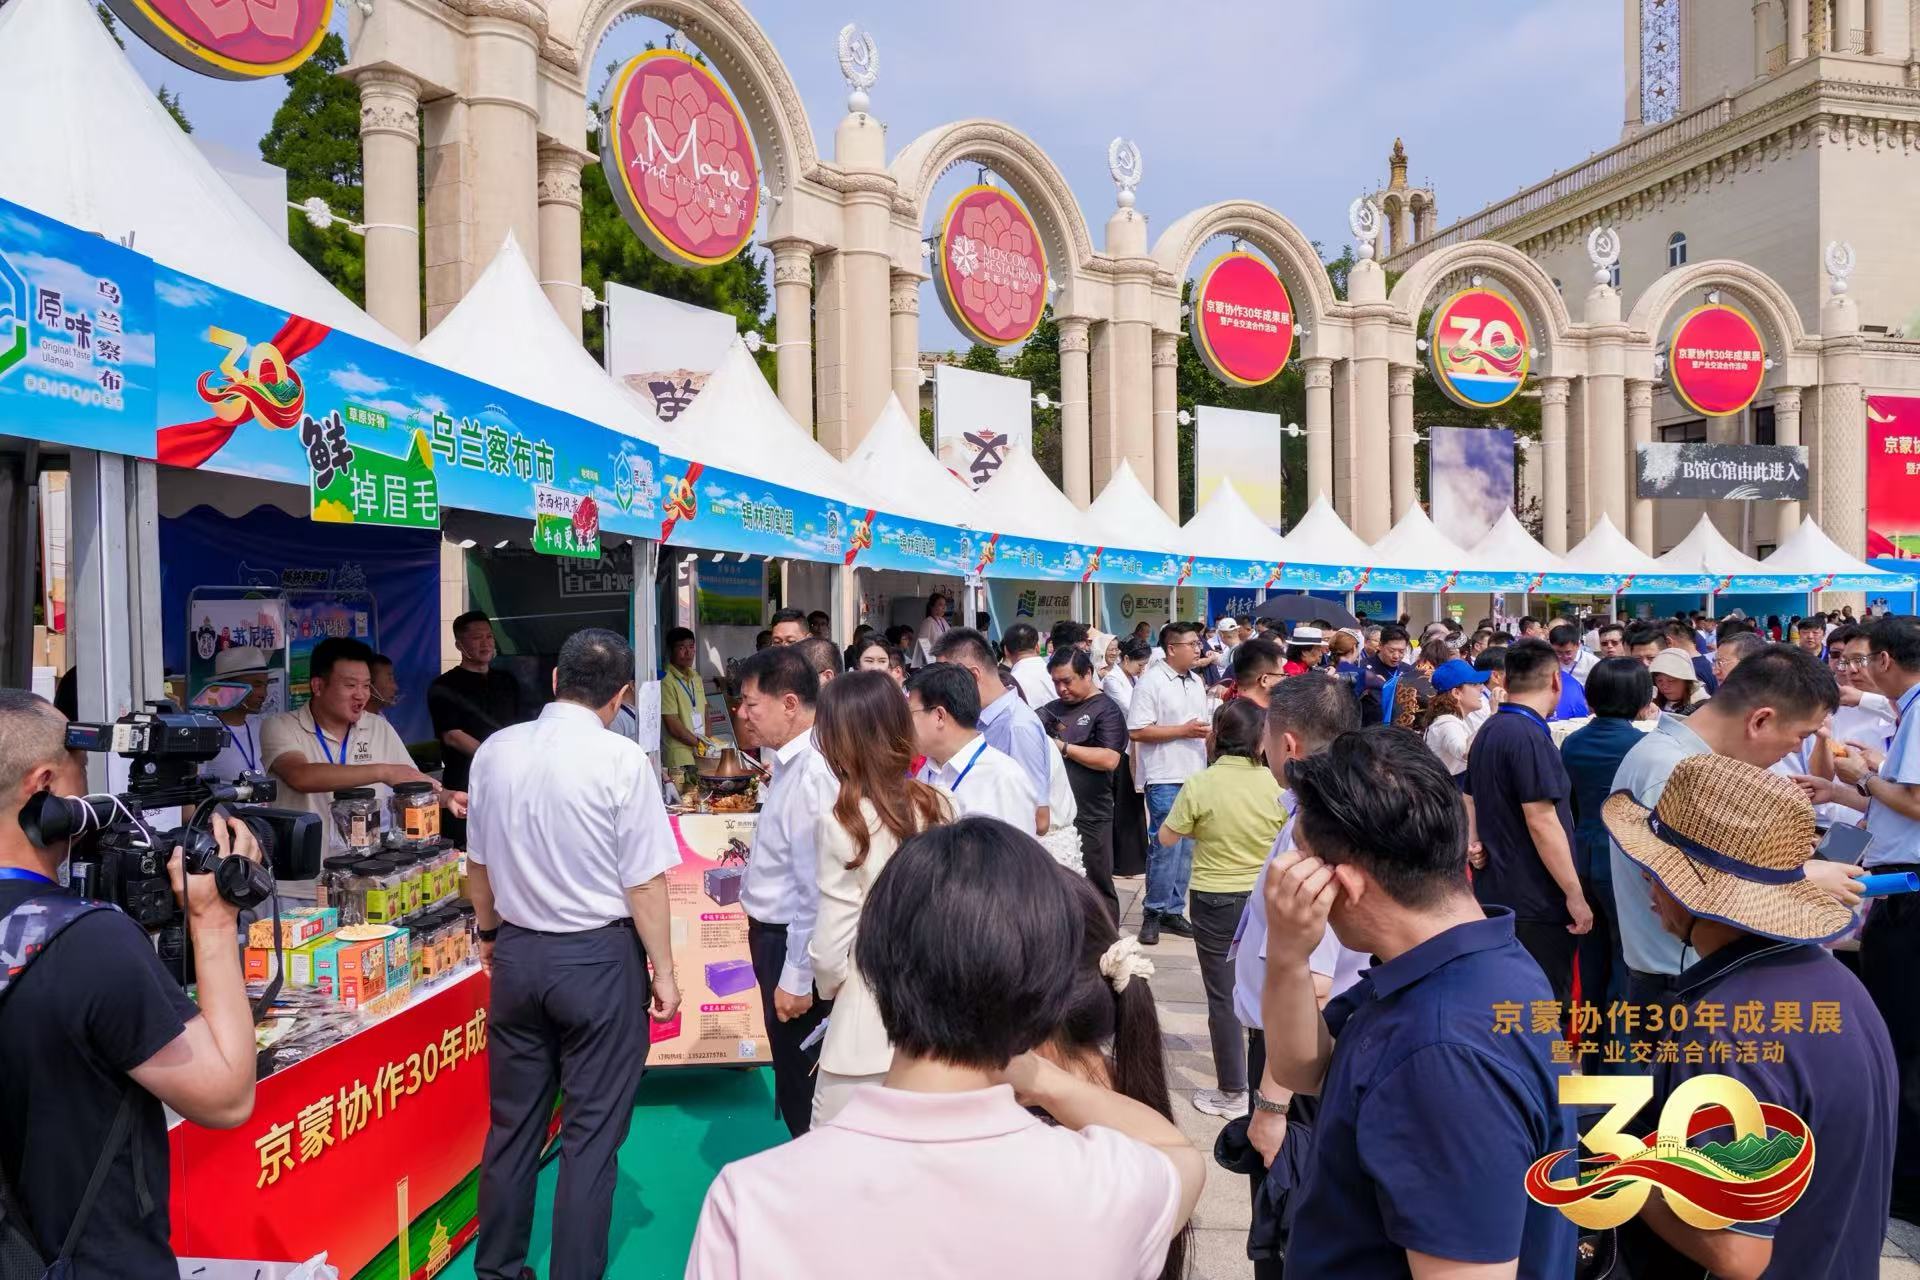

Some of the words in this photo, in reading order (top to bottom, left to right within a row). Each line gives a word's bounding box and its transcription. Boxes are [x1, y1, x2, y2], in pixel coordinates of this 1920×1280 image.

[983, 245, 1028, 271] MOSCOW
[983, 258, 1042, 285] RESTAURANT
[38, 288, 92, 350] 原味
[1206, 299, 1290, 325] 京蒙协作30年成果展
[97, 281, 121, 391] 乌兰察布
[42, 340, 72, 356] Original
[73, 348, 91, 361] Taste
[1678, 348, 1761, 362] 京蒙协作30年成果展
[430, 409, 555, 484] 乌兰察布市
[1682, 459, 1801, 483] B馆C馆由此进入
[350, 468, 437, 521] 掉眉毛
